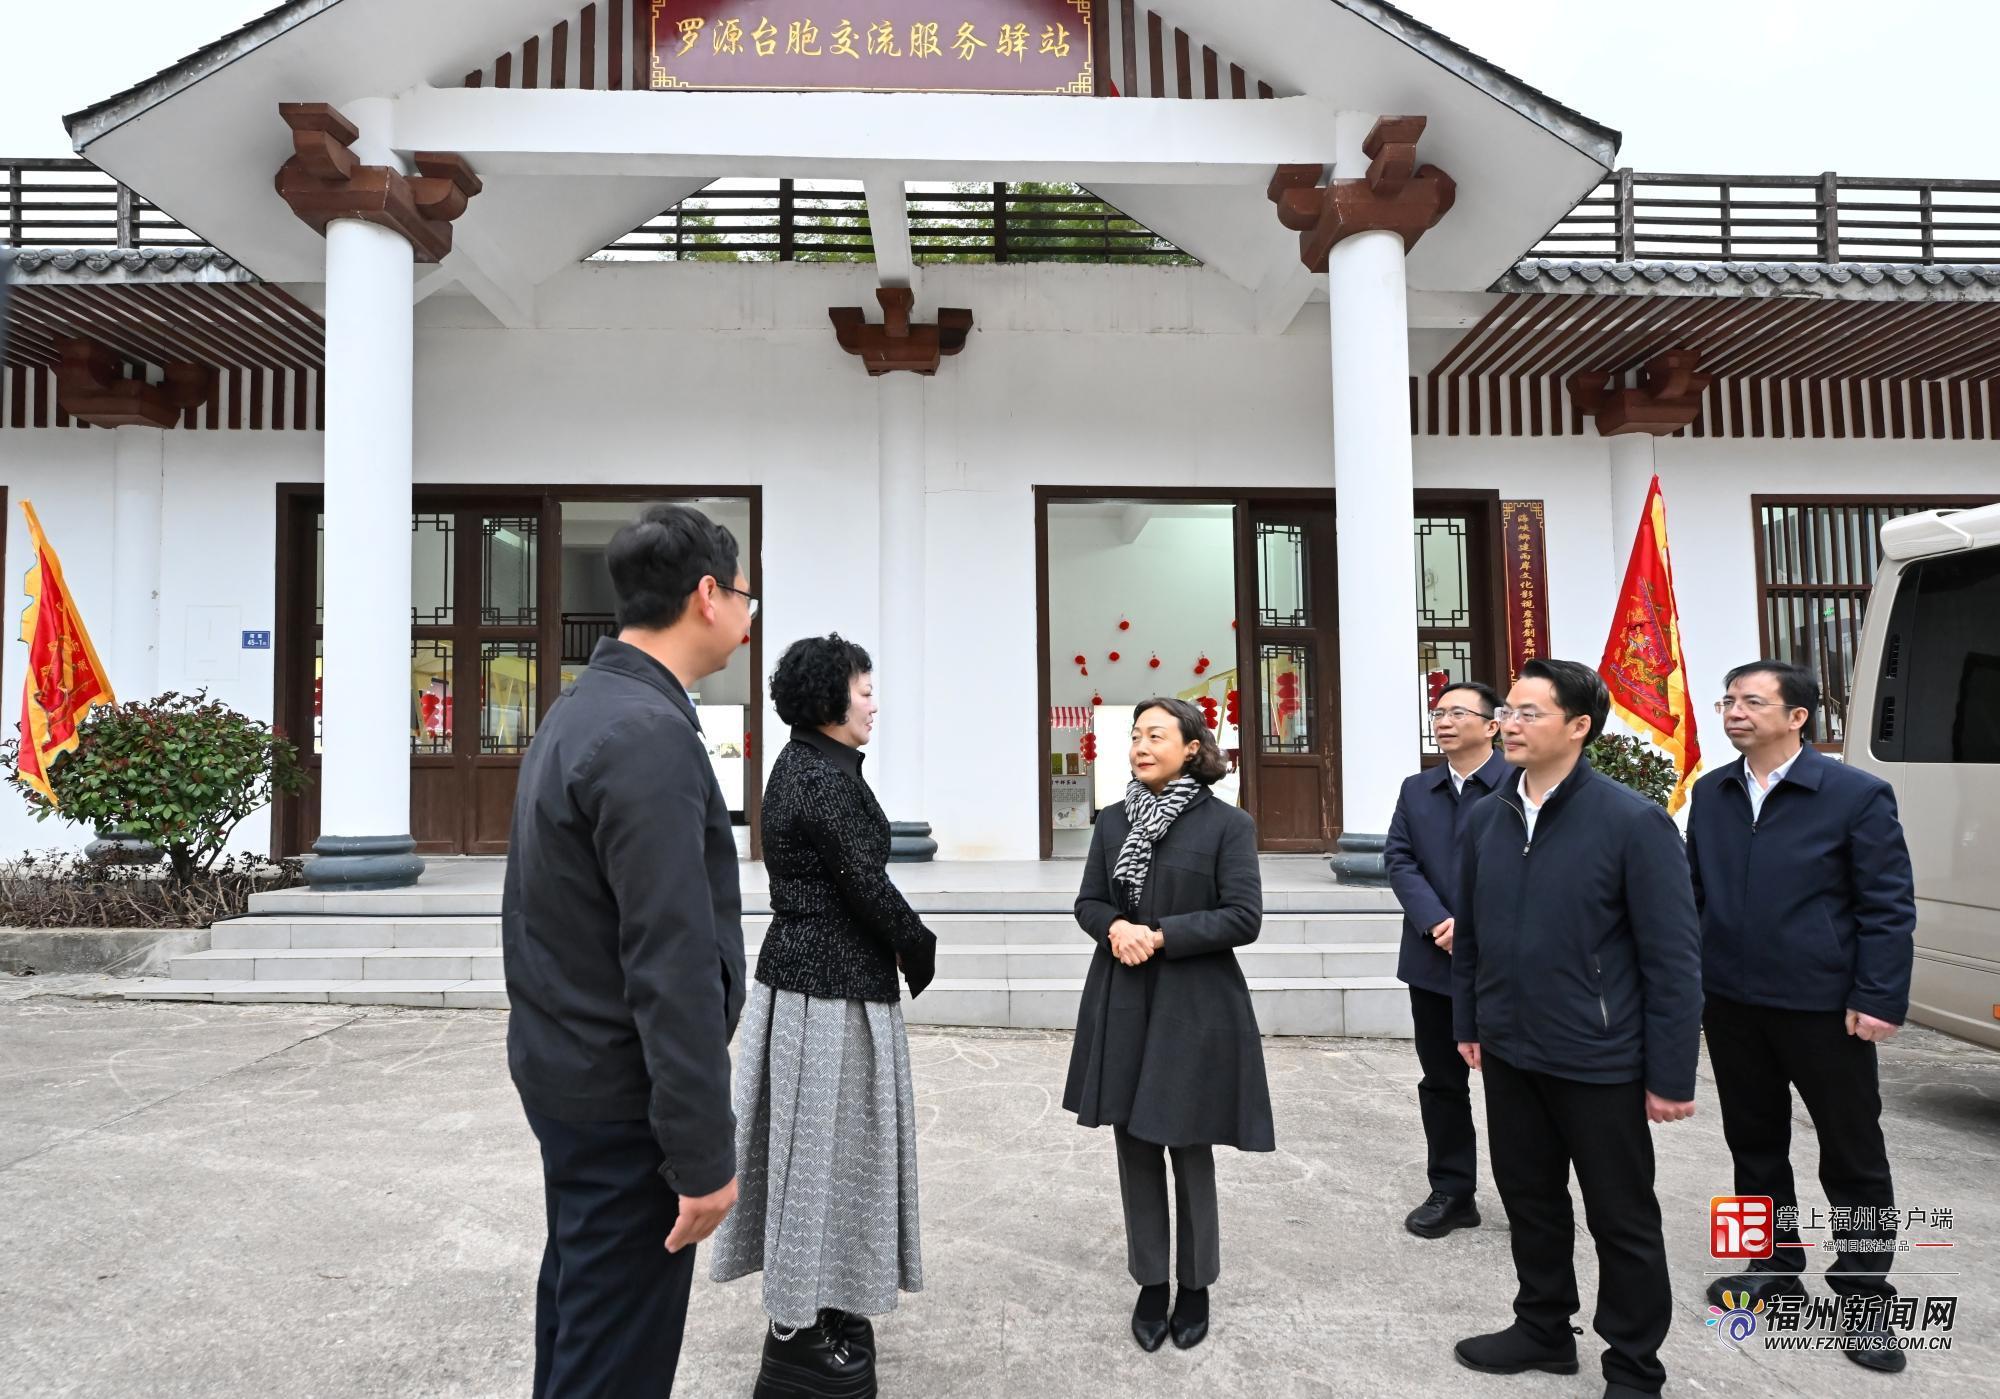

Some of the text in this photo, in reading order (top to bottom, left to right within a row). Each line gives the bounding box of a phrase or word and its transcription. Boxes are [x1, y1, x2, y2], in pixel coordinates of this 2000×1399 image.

[675, 16, 1071, 63] 罗源台胞交流服务驿站
